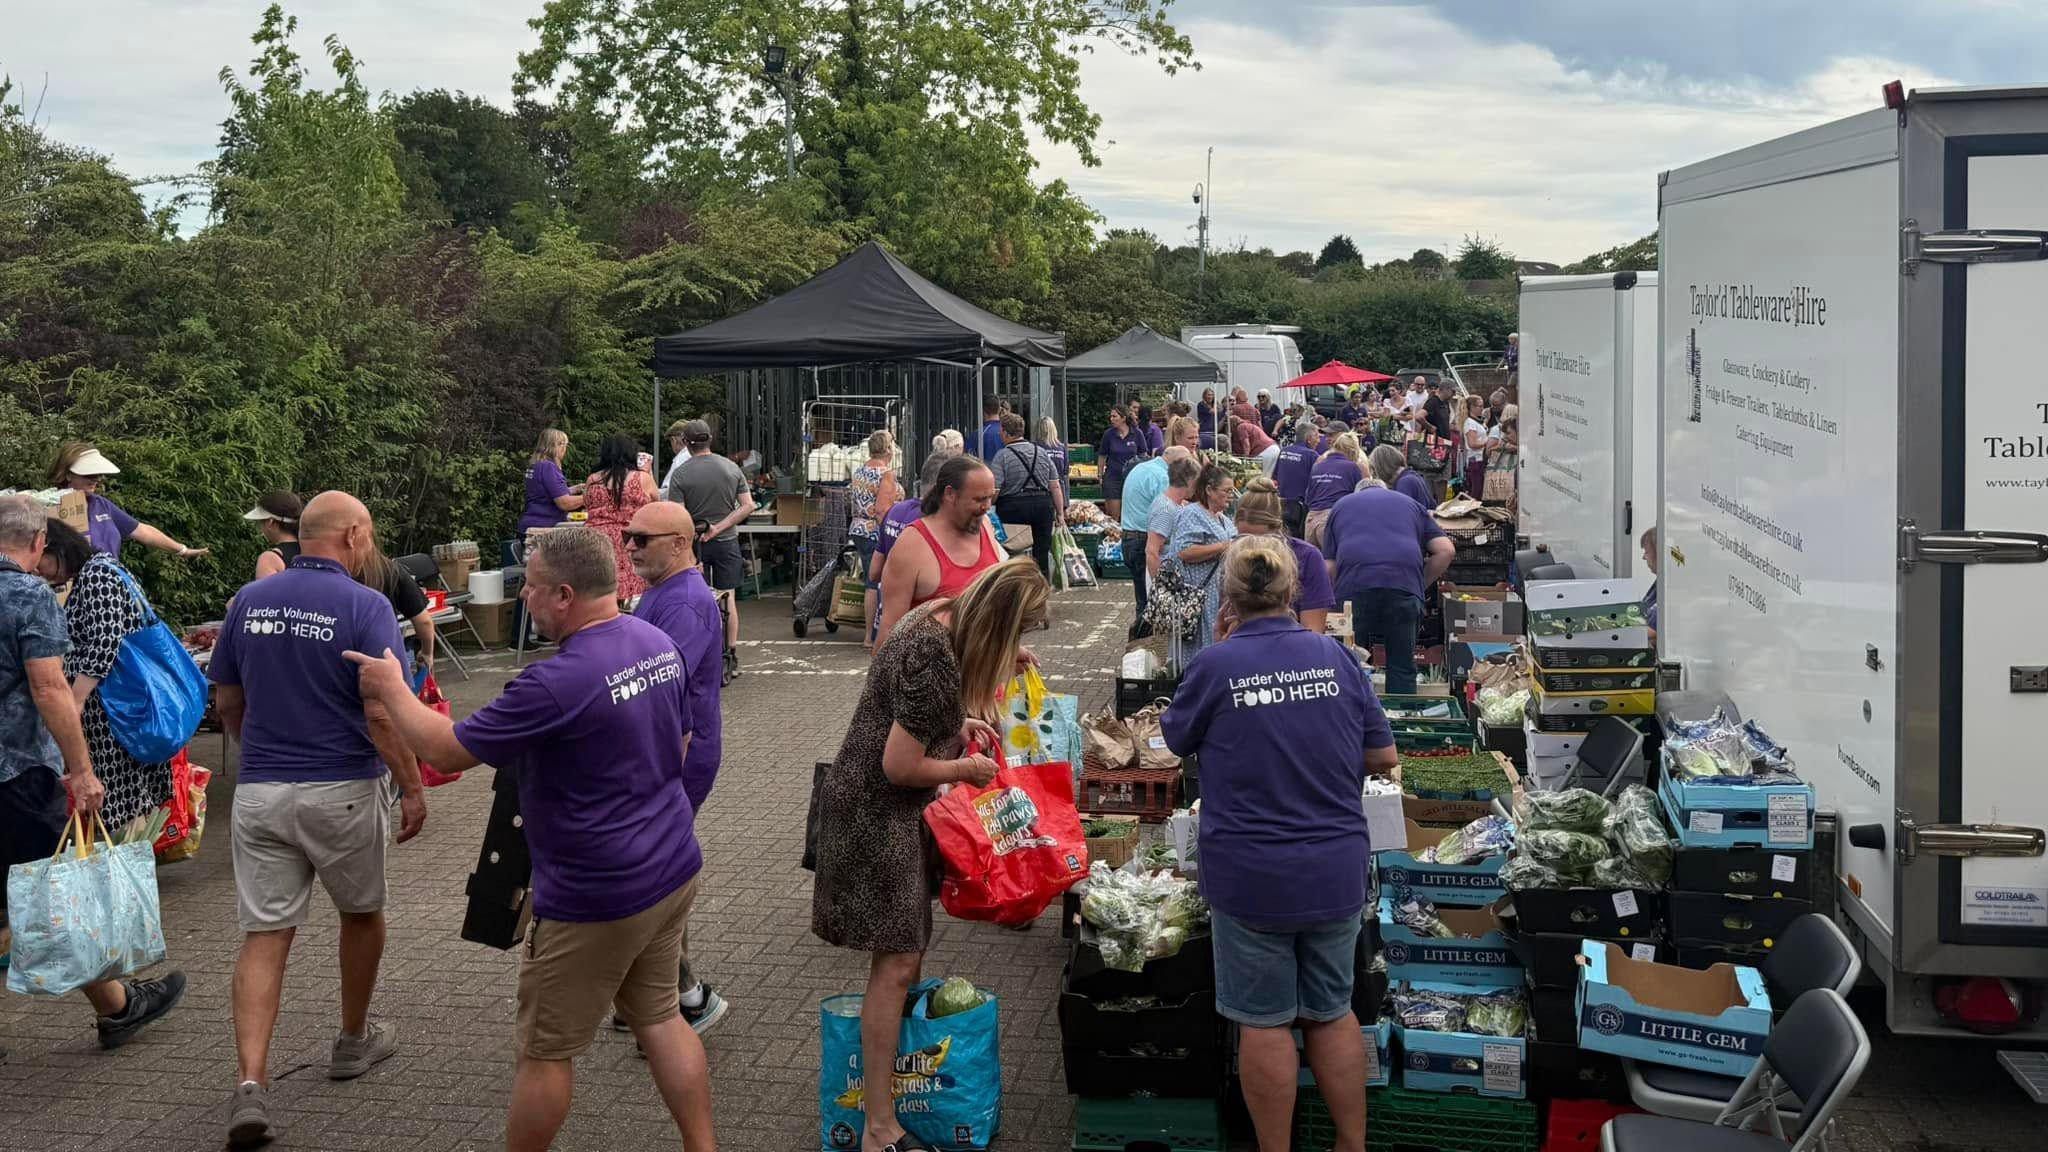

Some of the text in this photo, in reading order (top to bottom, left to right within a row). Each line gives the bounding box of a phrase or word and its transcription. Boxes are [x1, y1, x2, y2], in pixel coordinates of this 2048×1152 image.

[1690, 284, 1826, 326] Taylor'd Tableware Hire
[1817, 413, 1837, 435] Linen
[1984, 436, 2048, 458] Tabl
[246, 606, 338, 626] Larder Volunteer
[290, 621, 334, 642] HERO
[605, 665, 637, 687] Larder
[648, 662, 681, 687] HERO
[1229, 667, 1336, 690] Larder Volunteer
[1289, 680, 1340, 701] HERO
[1422, 874, 1467, 885] LITTLE
[1470, 876, 1500, 887] GEM
[1423, 949, 1472, 961] LITTLE
[1475, 951, 1506, 963] GEM
[1640, 1020, 1702, 1043] LITTLE
[1706, 1032, 1747, 1051] GEM
[934, 1076, 943, 1092] &
